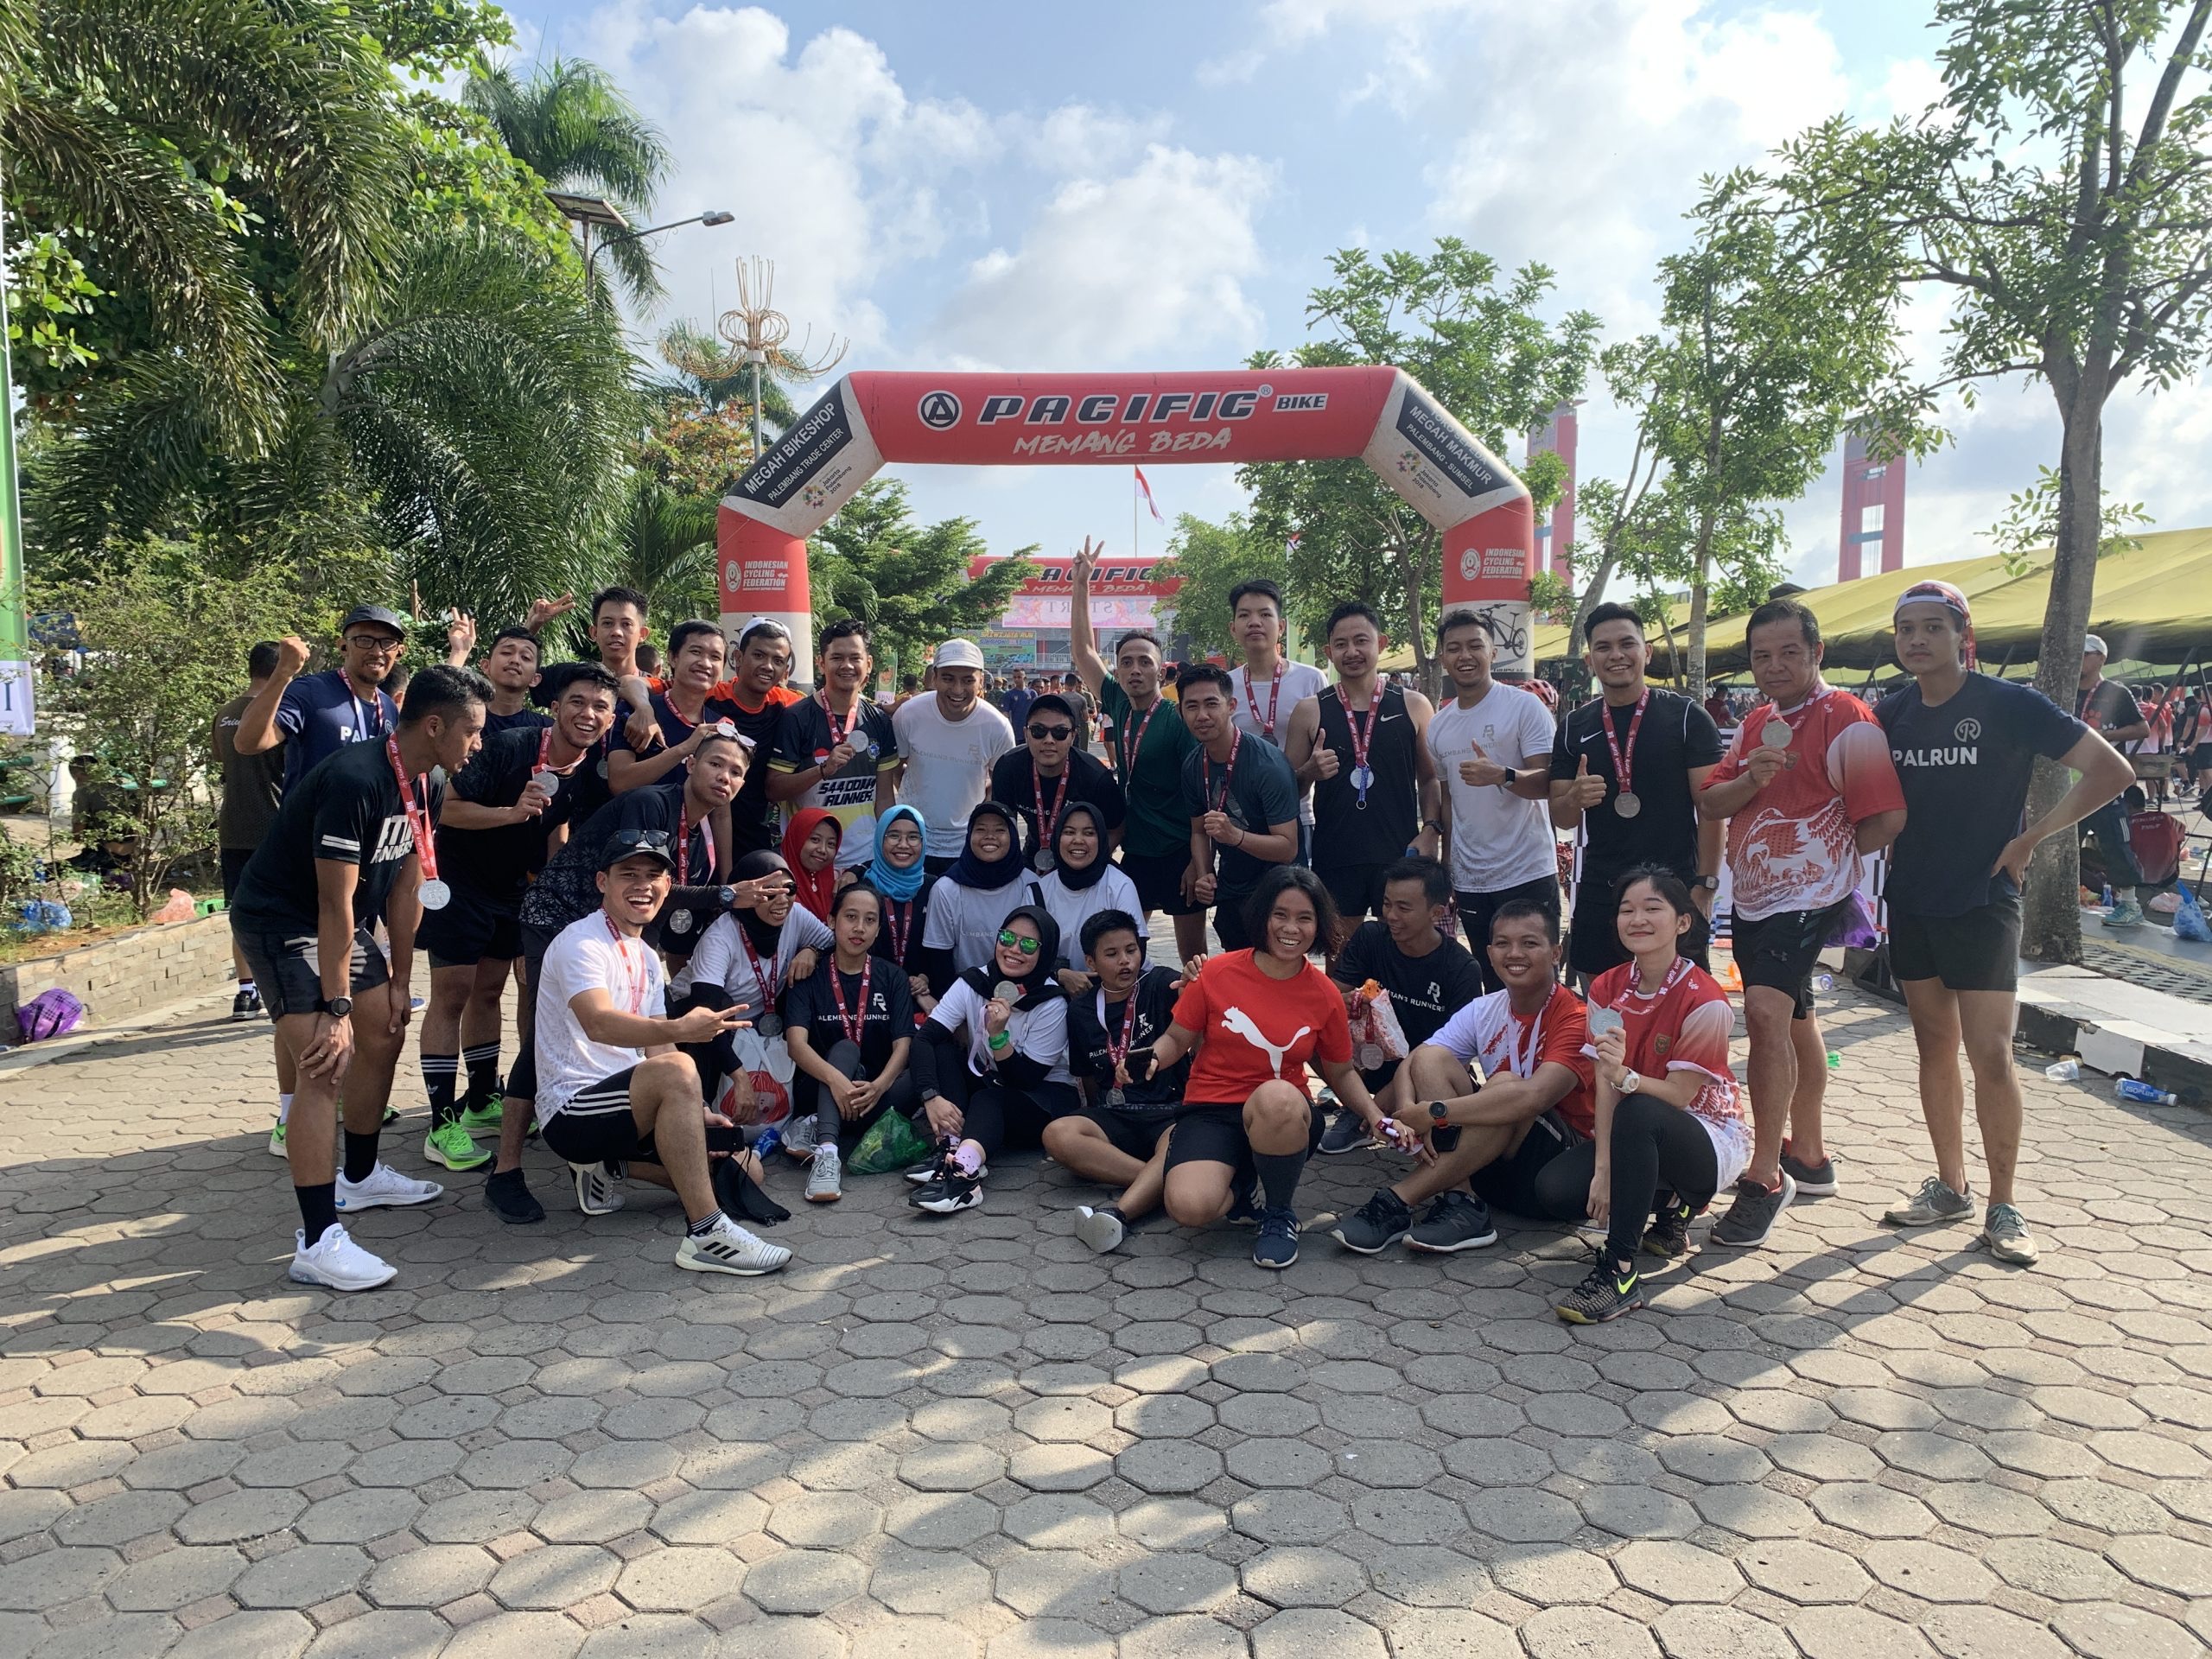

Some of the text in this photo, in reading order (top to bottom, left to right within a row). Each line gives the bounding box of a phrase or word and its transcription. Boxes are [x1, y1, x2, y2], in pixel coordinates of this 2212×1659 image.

[976, 391, 1326, 425] PACIFIC BIKE
[744, 403, 835, 494] MEGAH BIKESHOP
[1013, 427, 1231, 455] MEMANG BEDA
[1409, 406, 1448, 443] MEGAH
[1446, 440, 1492, 485] MAKMUR
[767, 467, 804, 501] PALEMBANG
[800, 448, 823, 468] TRADE
[819, 428, 844, 452] CENTER
[1407, 423, 1446, 461] PALEMBANG
[1447, 464, 1473, 490] SUMSEL
[823, 469, 841, 486] Jakarta
[826, 466, 852, 491] Palembang
[1413, 478, 1424, 490] 2018
[1416, 473, 1441, 499] Palembang
[1420, 469, 1439, 487] Jakarta
[830, 483, 842, 494] 2018
[1485, 548, 1525, 557] INDONESIAN
[745, 561, 789, 569] INDONESIAN
[1484, 557, 1515, 566] CYCLING
[743, 569, 775, 578] CYCLING
[1482, 566, 1522, 575] FEDERATION
[743, 578, 785, 587] FEDERATION
[1103, 583, 1145, 593] BEDA
[1891, 747, 1978, 767] PALRUN
